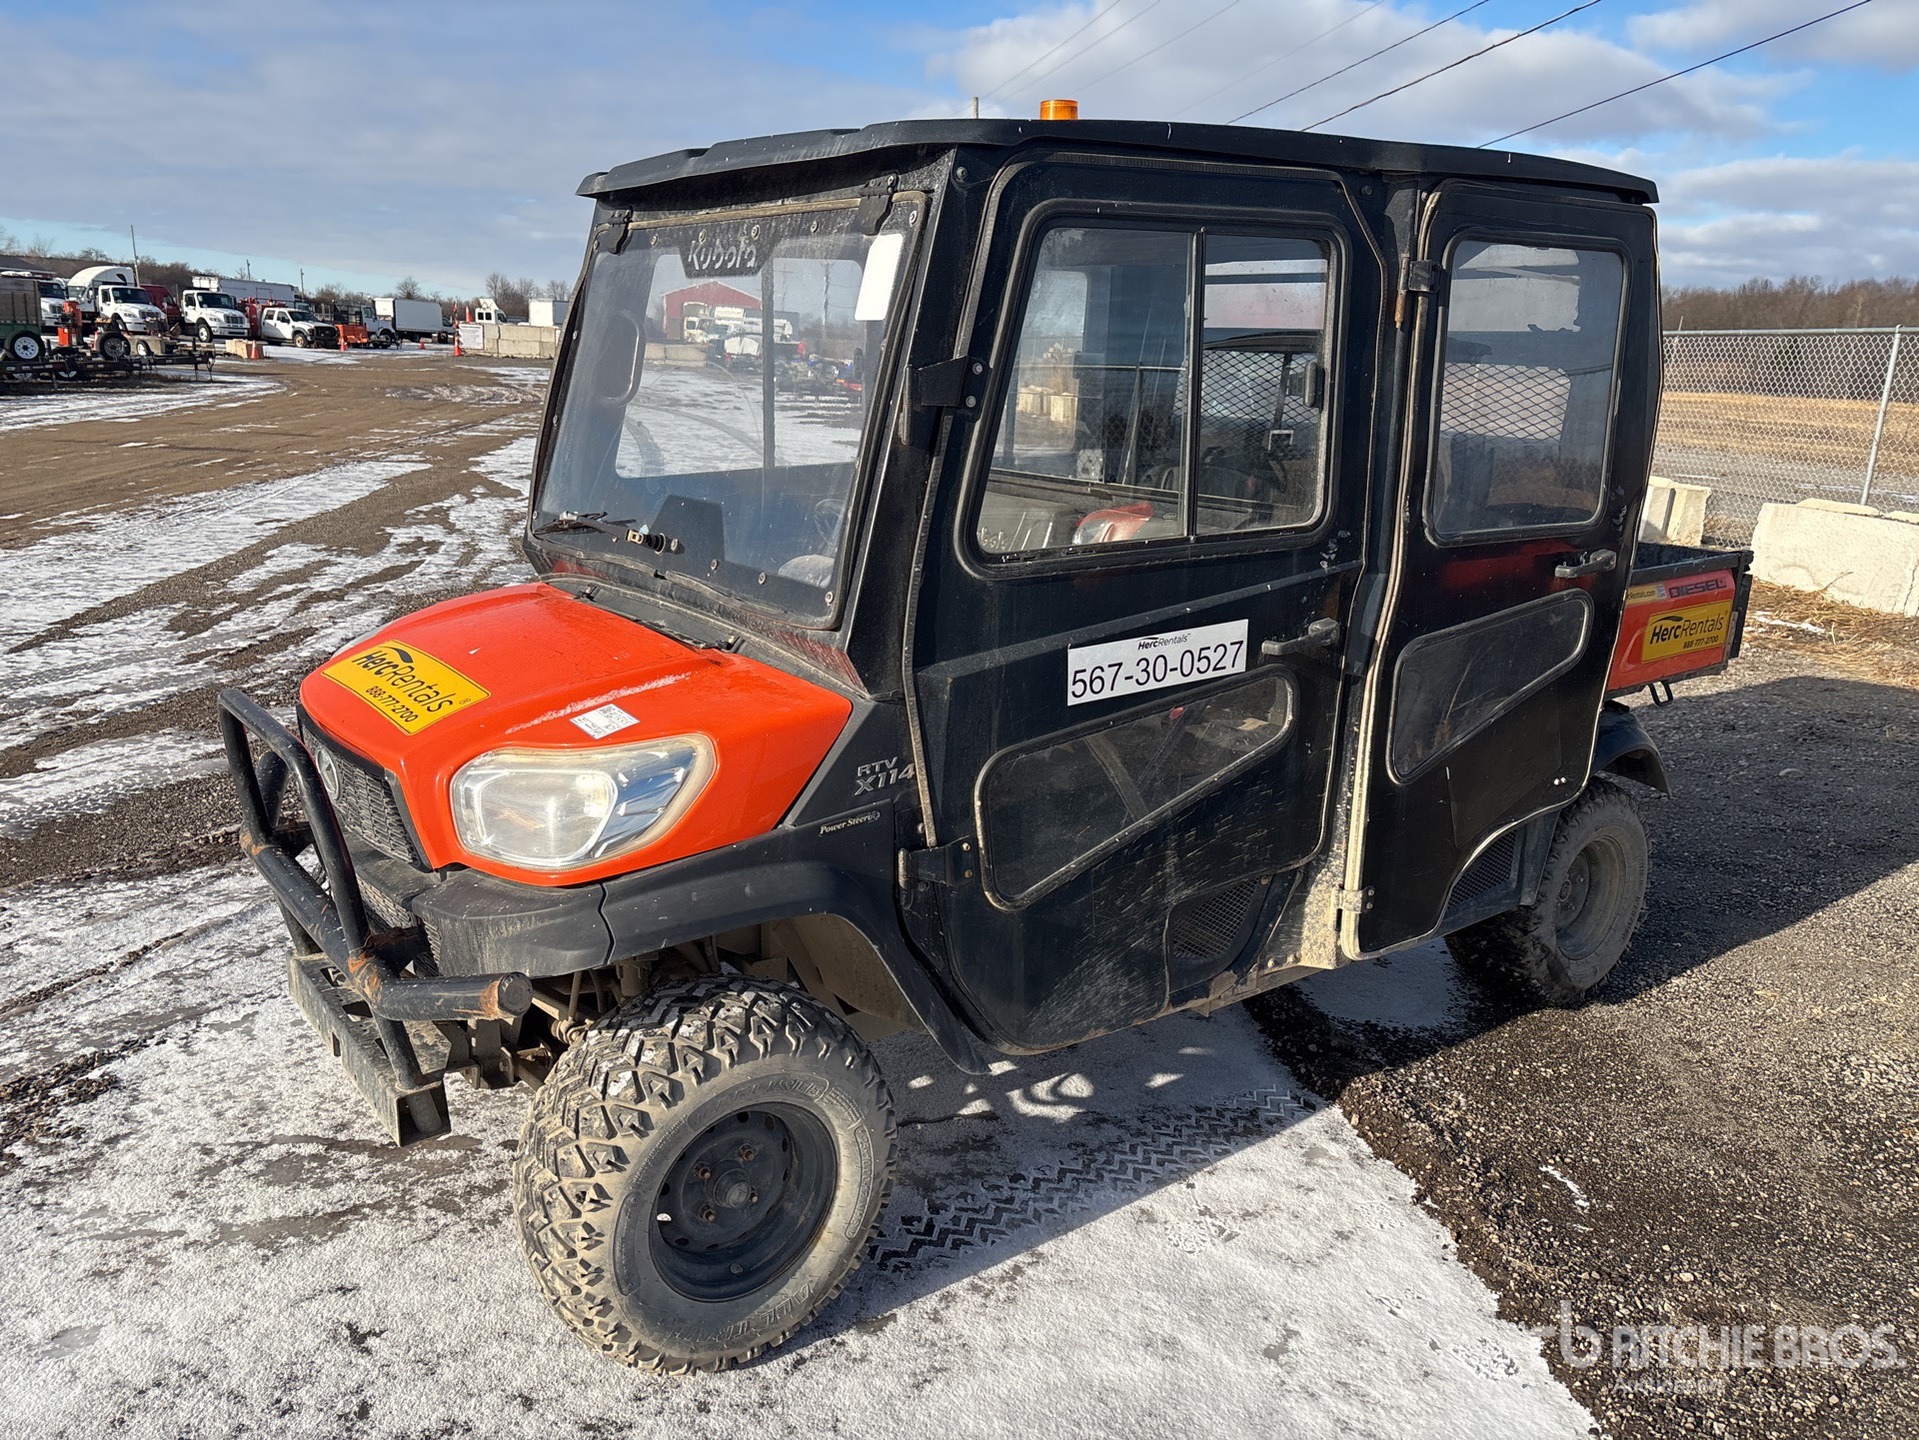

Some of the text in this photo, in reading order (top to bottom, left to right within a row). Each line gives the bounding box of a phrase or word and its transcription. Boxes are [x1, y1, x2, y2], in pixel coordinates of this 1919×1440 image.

[1669, 579, 1727, 598] DIESEL
[1650, 613, 1725, 645] HercRentals
[1137, 633, 1189, 650] HercRentals
[1683, 635, 1719, 649] 888-777-2700
[1071, 640, 1244, 698] 567-30-0527
[352, 650, 456, 712] HercRentals
[365, 686, 418, 722] 888-777-2700
[857, 756, 898, 777] RTV
[819, 822, 847, 836] Power
